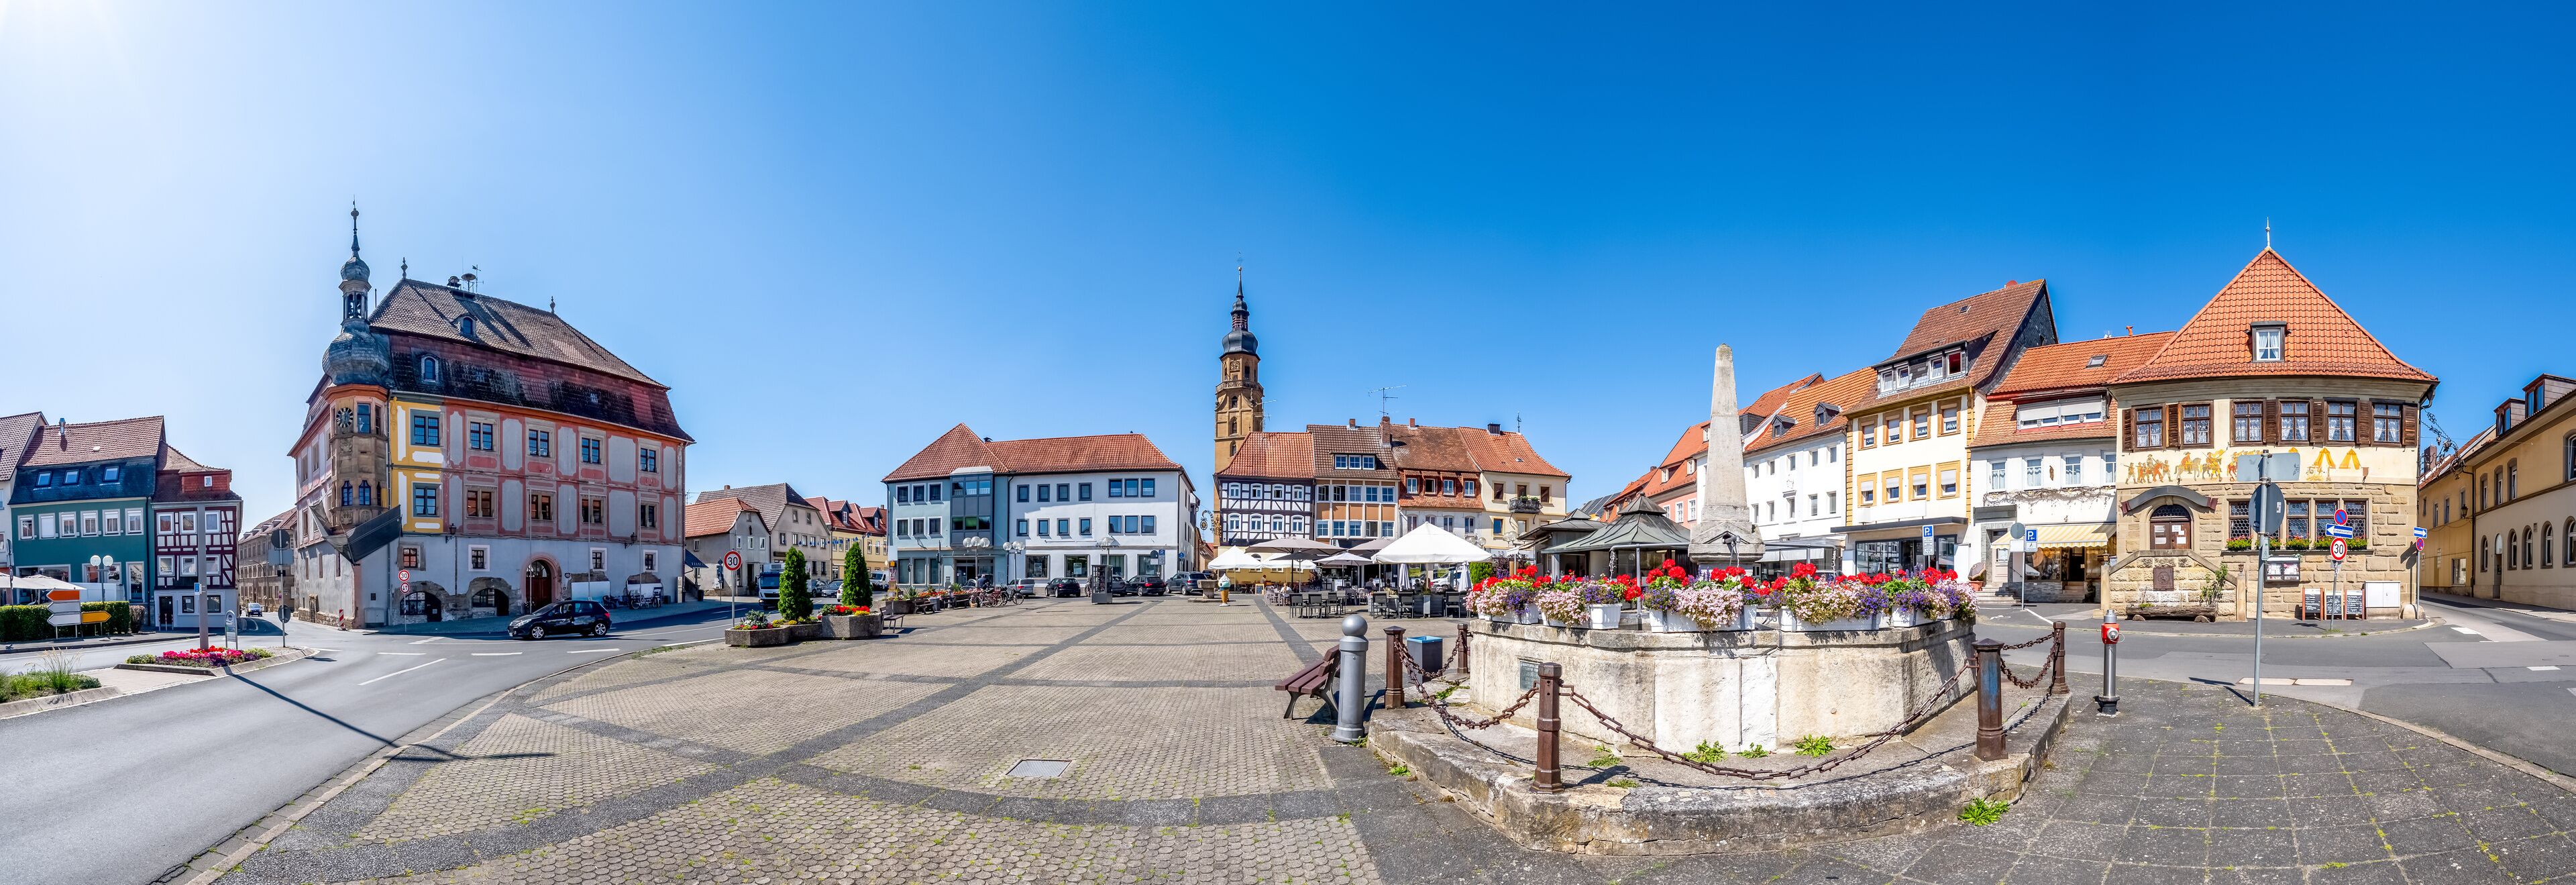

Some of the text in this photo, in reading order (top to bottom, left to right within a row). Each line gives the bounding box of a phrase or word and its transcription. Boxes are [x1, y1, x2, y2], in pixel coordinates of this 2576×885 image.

[1925, 527, 1930, 536] P
[2027, 531, 2033, 540] P
[2334, 543, 2344, 554] 30
[727, 557, 738, 566] 30
